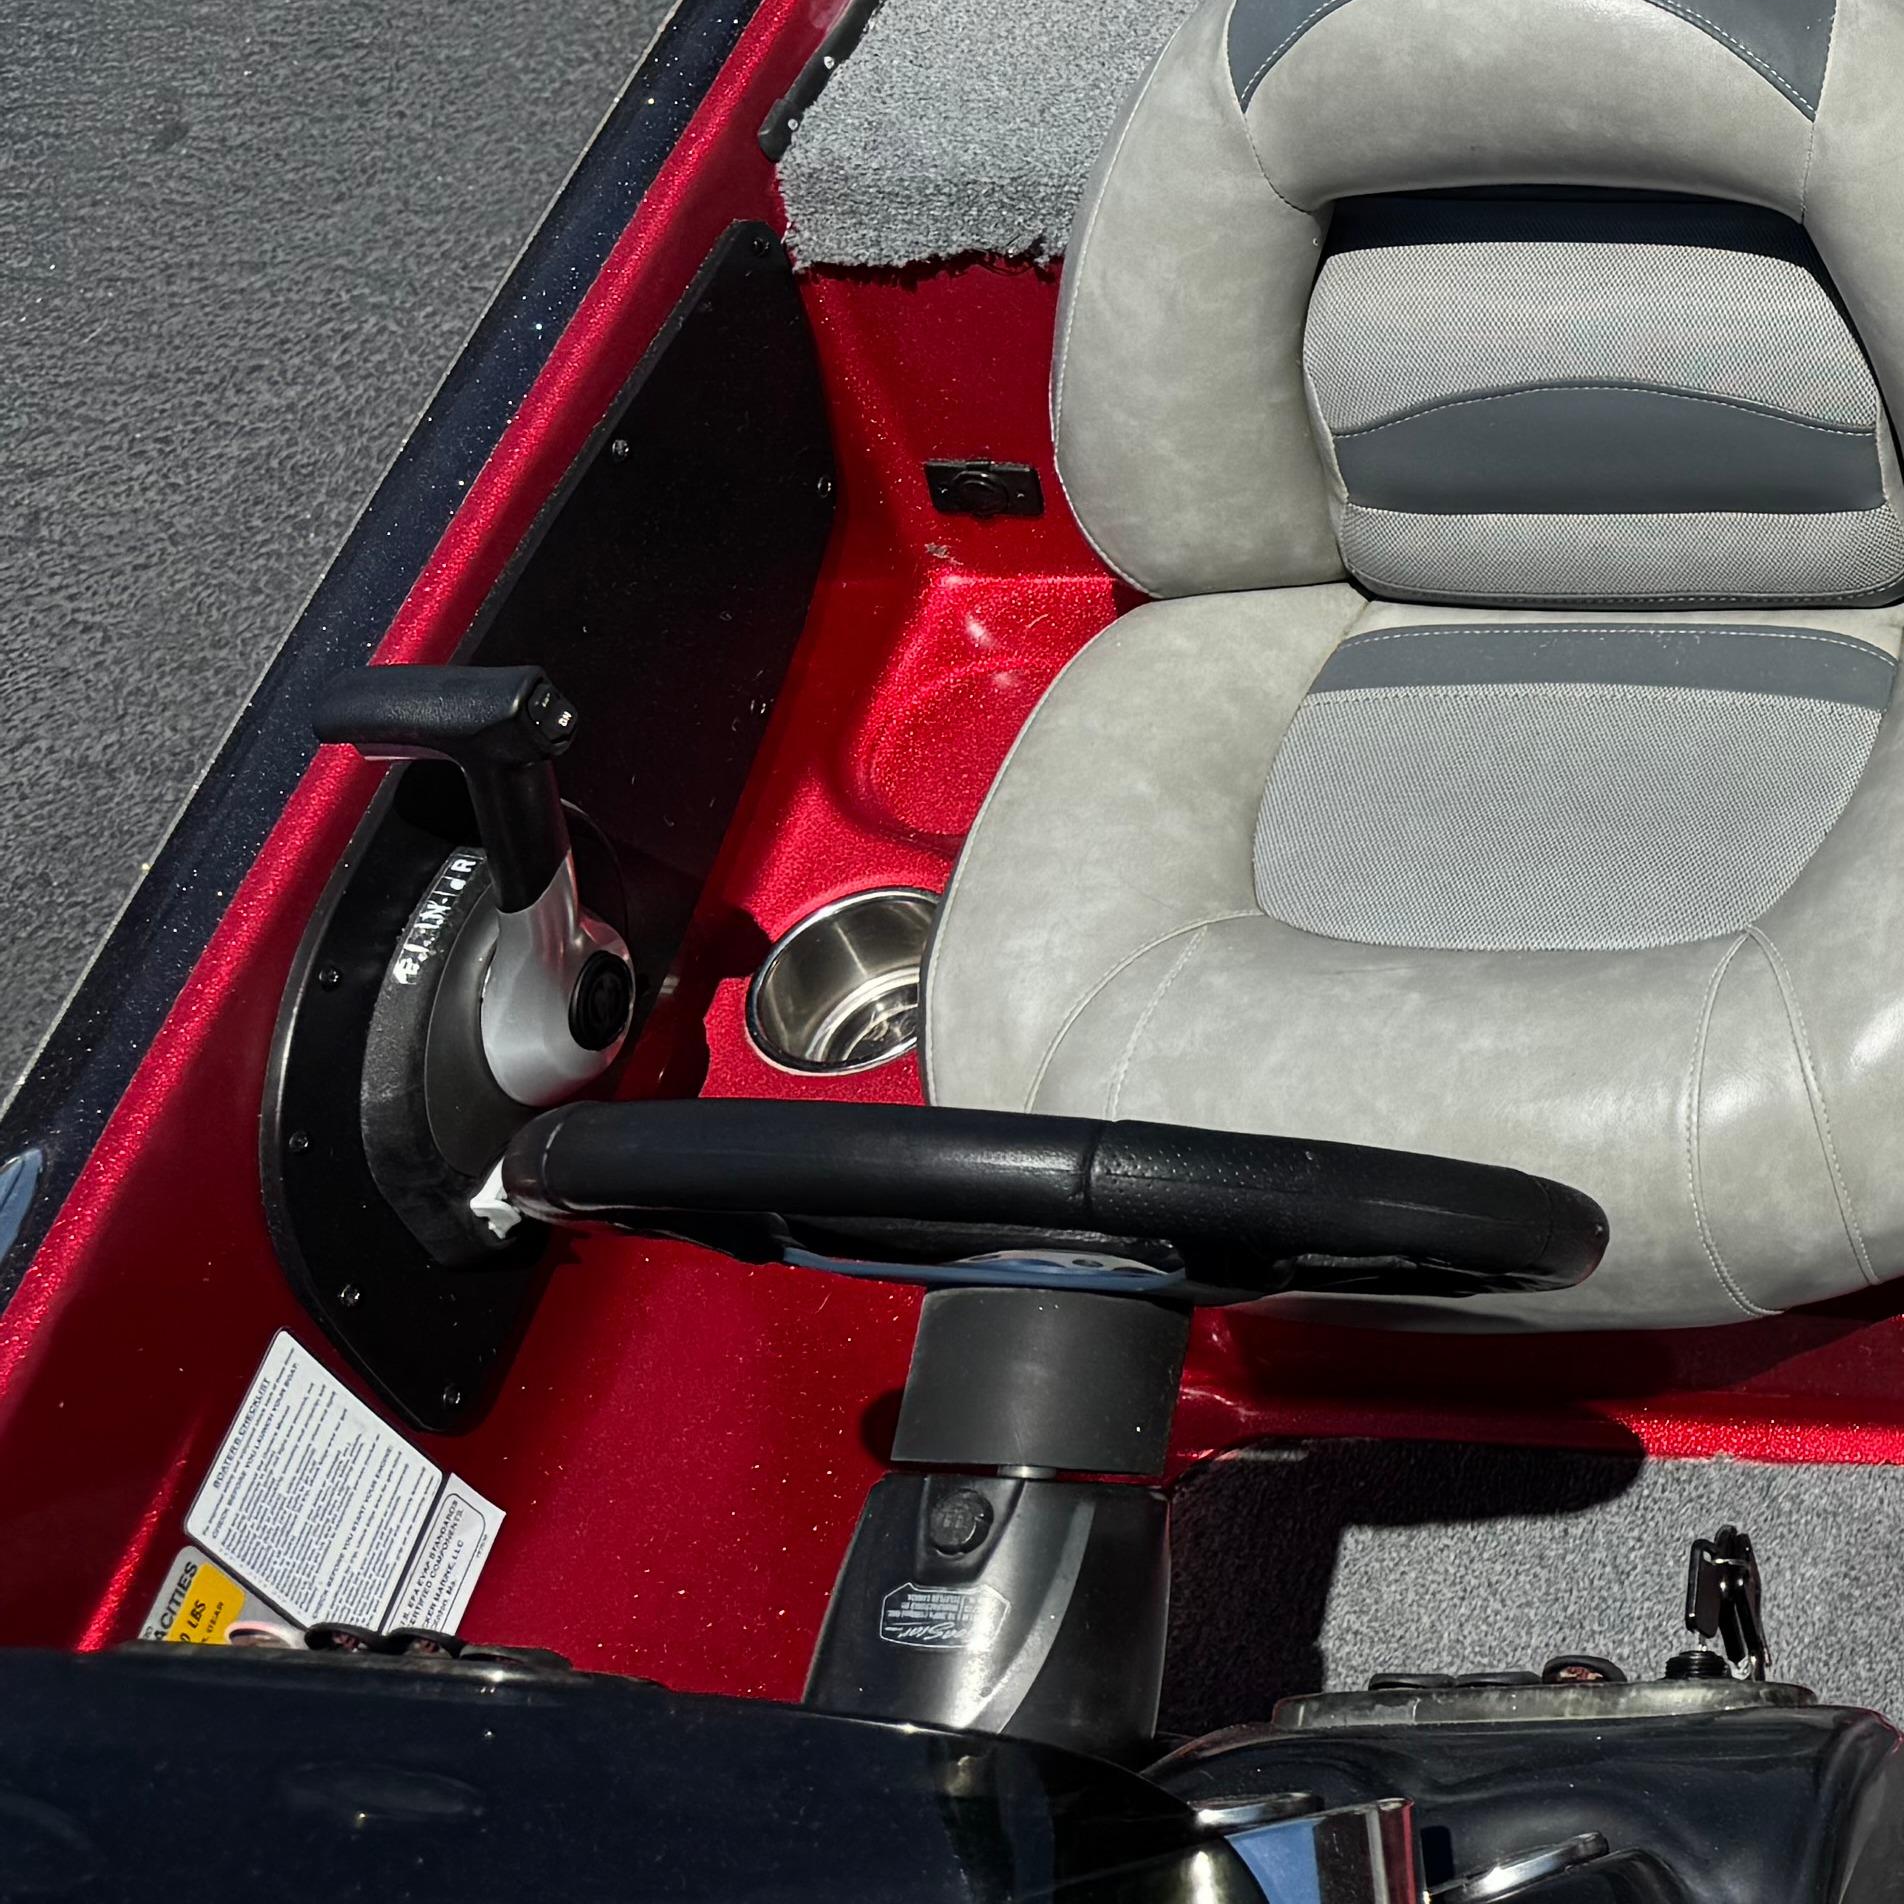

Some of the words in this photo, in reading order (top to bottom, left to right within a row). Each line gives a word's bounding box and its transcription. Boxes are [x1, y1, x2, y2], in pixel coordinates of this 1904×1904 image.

[408, 1589, 419, 1608] EPA
[429, 1500, 458, 1559] STANDARDS
[452, 1540, 463, 1560] LLC
[152, 1561, 198, 1641] ACITIES
[187, 1600, 206, 1629] LBS
